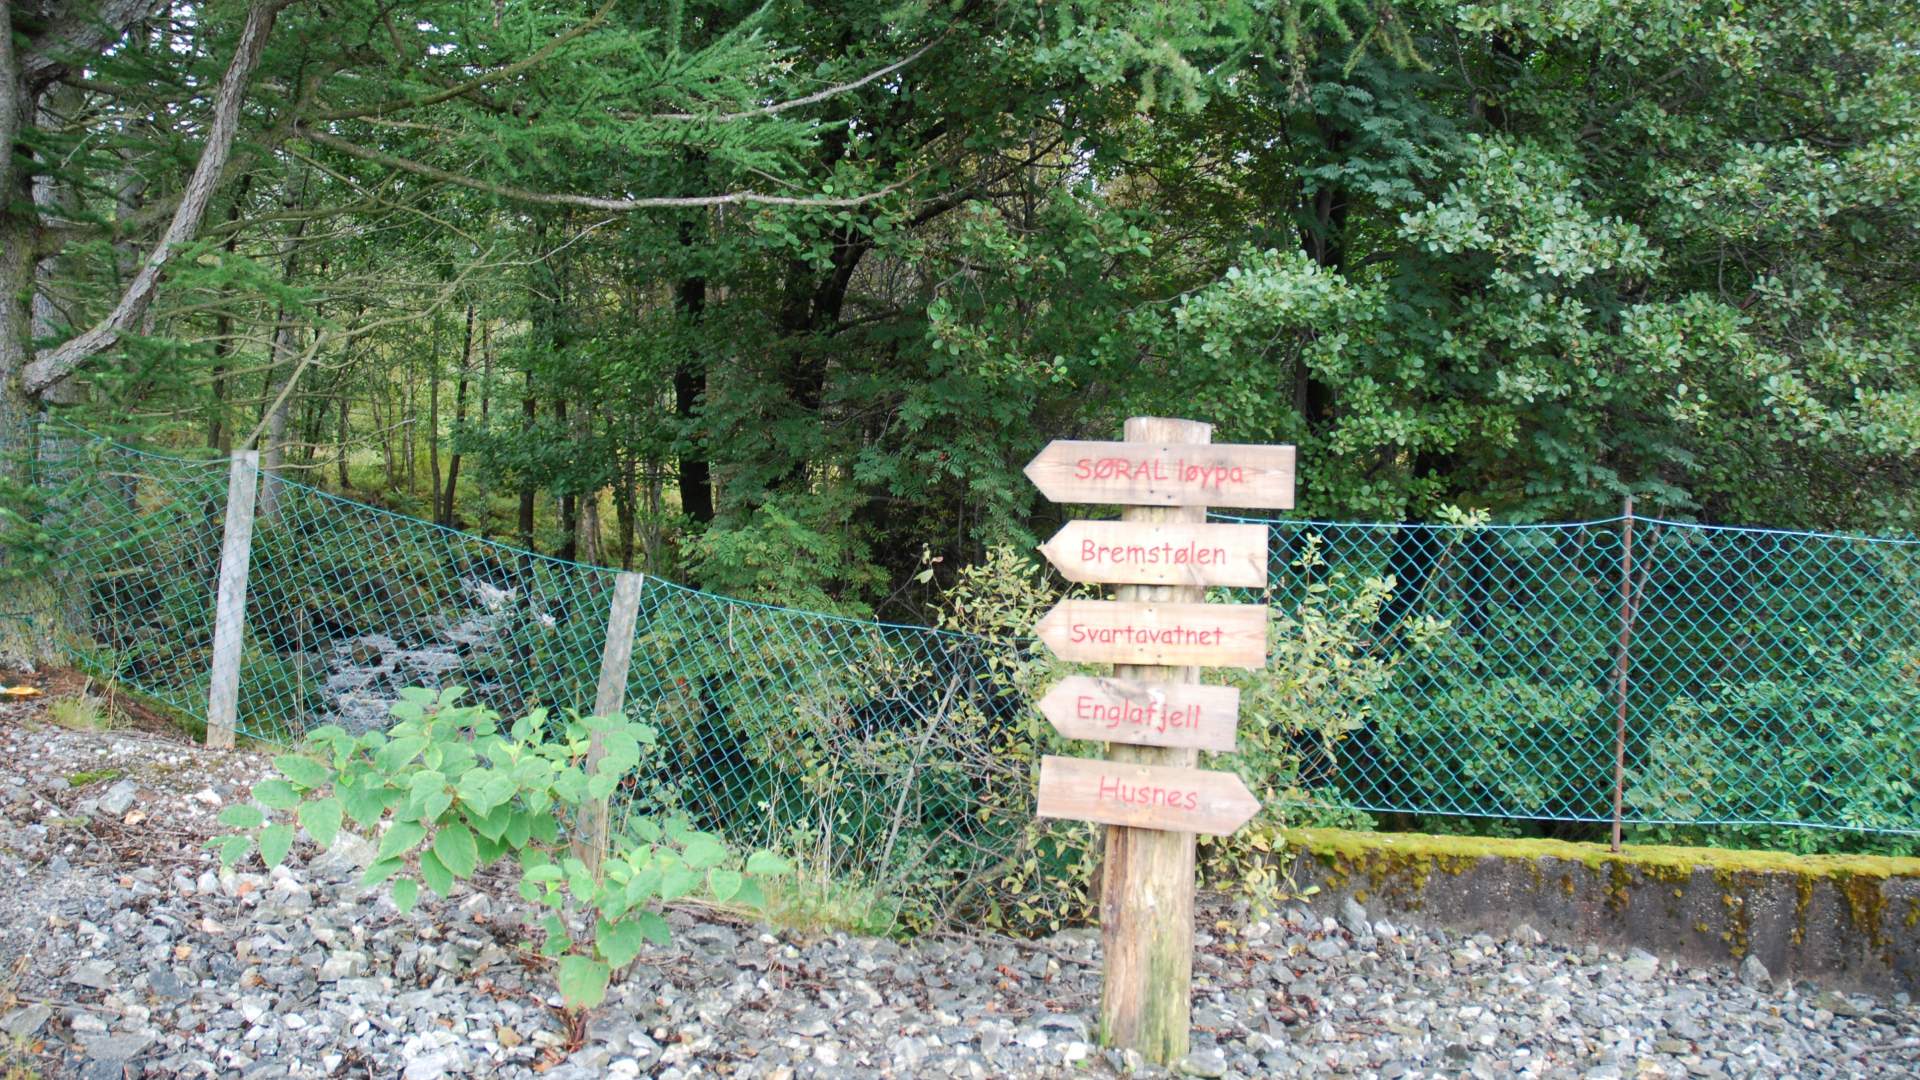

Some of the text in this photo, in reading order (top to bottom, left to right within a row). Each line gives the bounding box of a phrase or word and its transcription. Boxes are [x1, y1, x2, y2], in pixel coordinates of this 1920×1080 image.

[1075, 458, 1244, 488] SØRAL løypa
[1081, 539, 1226, 565] Bremstølen
[1071, 624, 1223, 646] Svartavatnet
[1077, 695, 1201, 734] Englafjell
[1099, 775, 1197, 810] Husnes
